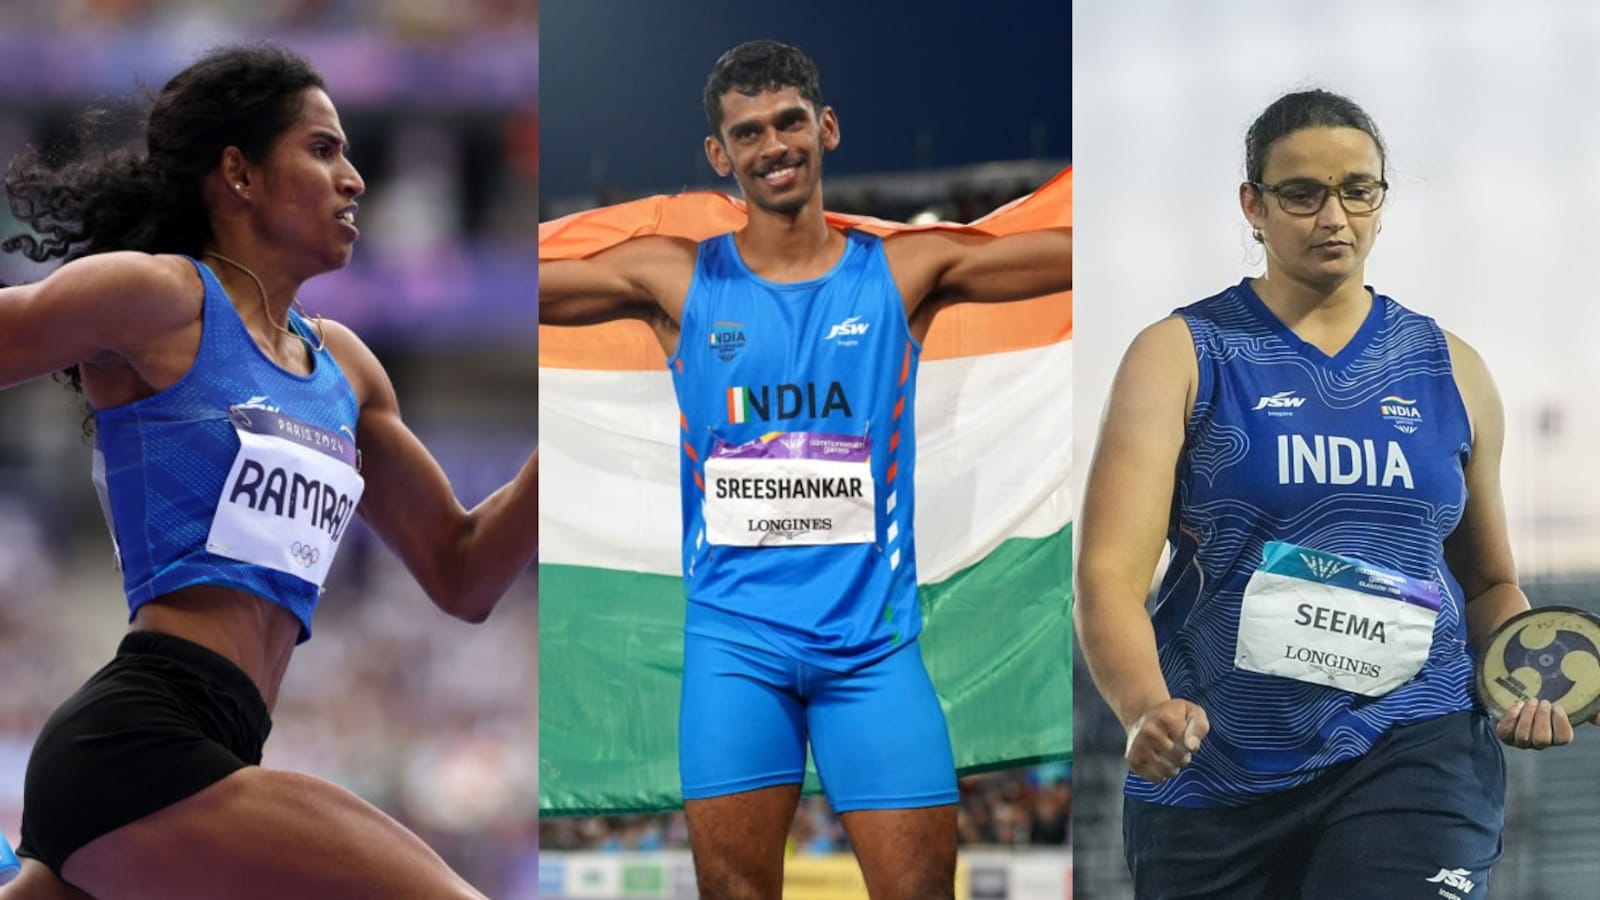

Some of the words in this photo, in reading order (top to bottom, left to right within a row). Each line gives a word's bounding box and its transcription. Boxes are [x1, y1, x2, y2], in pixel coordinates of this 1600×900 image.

[709, 331, 746, 345] INDIA
[727, 381, 852, 424] INDIA
[1251, 397, 1306, 410] JSW
[1381, 405, 1421, 418] INDIA
[278, 419, 312, 441] PARIS
[315, 431, 344, 455] 2024
[1278, 434, 1415, 489] INDIA
[716, 477, 863, 500] SREESHANKAR
[748, 518, 832, 532] LONGINES
[1294, 603, 1387, 645] SEEMA
[1284, 645, 1382, 679] LONGINES
